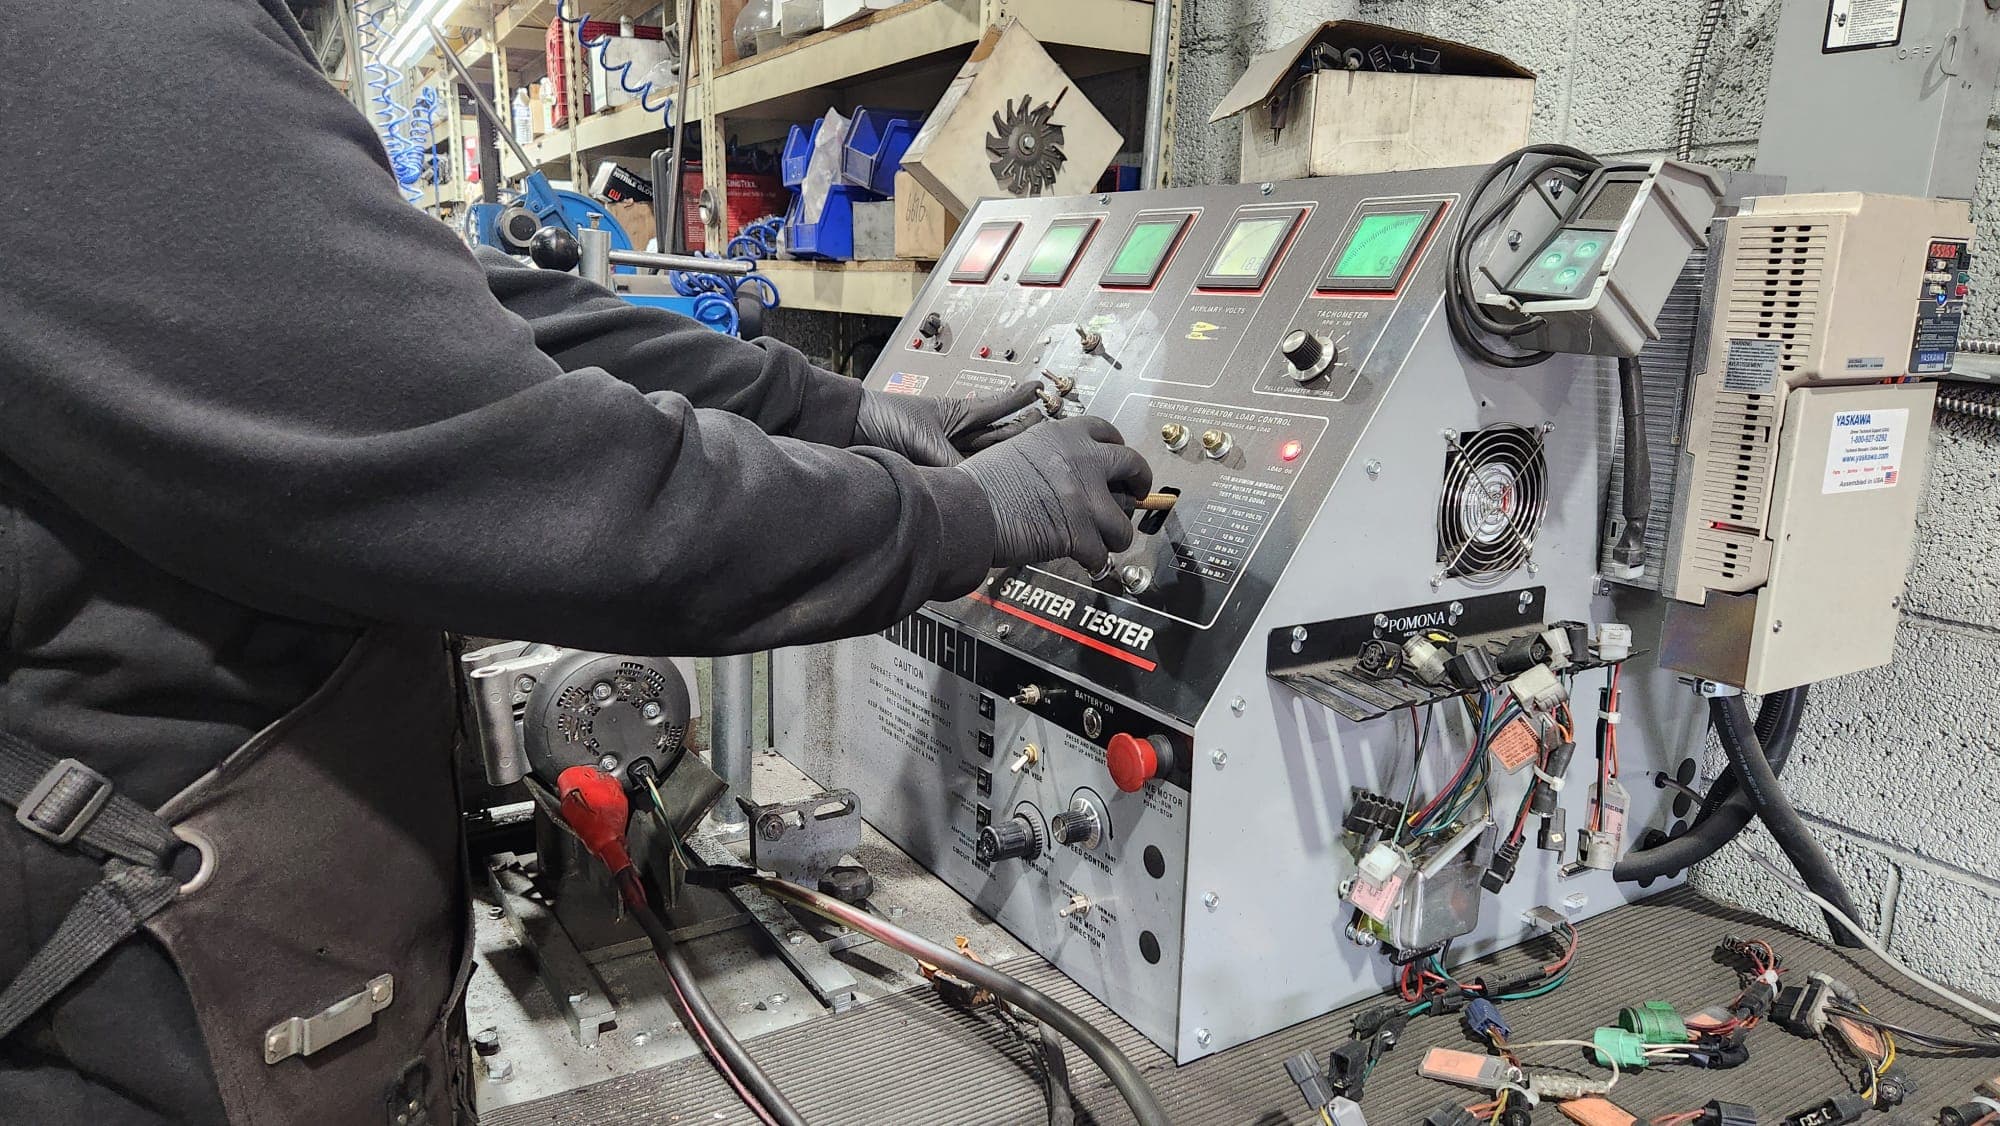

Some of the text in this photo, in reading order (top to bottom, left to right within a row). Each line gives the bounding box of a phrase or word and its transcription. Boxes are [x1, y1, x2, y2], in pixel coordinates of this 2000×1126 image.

[1190, 305, 1246, 314] AUXILIARY VOLTS
[1316, 310, 1369, 319] TACHOMETER
[1148, 400, 1292, 426] ALTERNATOR GENERATOR LOAD CONTROL
[1836, 413, 1871, 426] YASKAWA
[1842, 453, 1889, 464] www.yaskawa.com
[1267, 465, 1282, 473] LOAD
[1211, 481, 1232, 489] OUTPUT
[1232, 485, 1252, 493] ROTATE
[1268, 492, 1284, 500] UNTIL
[1230, 477, 1255, 486] MAXIMUM
[1255, 480, 1285, 492] AMPERAGE
[1840, 479, 1867, 487] Assembled
[1248, 497, 1266, 505] EQUAL
[1206, 504, 1227, 513] SYSTEM
[1245, 512, 1263, 521] VOLTS
[1000, 577, 1154, 650] STARTER TESTER
[1389, 611, 1446, 633] POMONA
[894, 656, 924, 680] CAUTION
[870, 662, 893, 680] OPERATE
[906, 682, 928, 699] MACHINE
[930, 694, 950, 711] SAFELY
[884, 685, 903, 701] OPERATE
[912, 702, 931, 717] MACHINE
[932, 712, 952, 728] WITHOUT
[1074, 689, 1114, 714] BATTERY ON
[914, 727, 929, 740] LOOSE
[931, 735, 953, 754] CLOTHING
[1064, 740, 1078, 751] START
[1065, 733, 1079, 745] PRESS
[1157, 787, 1183, 808] MOTOR
[1160, 808, 1173, 818] STOP
[952, 846, 996, 880] CIRCUIT BREAKERS
[1043, 851, 1054, 863] MORE
[1066, 842, 1113, 876] PEED CONTROL
[1105, 852, 1116, 863] FAST
[1025, 857, 1048, 878] TENSION
[1095, 904, 1117, 922] FORWARD
[1069, 922, 1101, 949] DIRECTION
[1084, 919, 1106, 941] MOTOR
